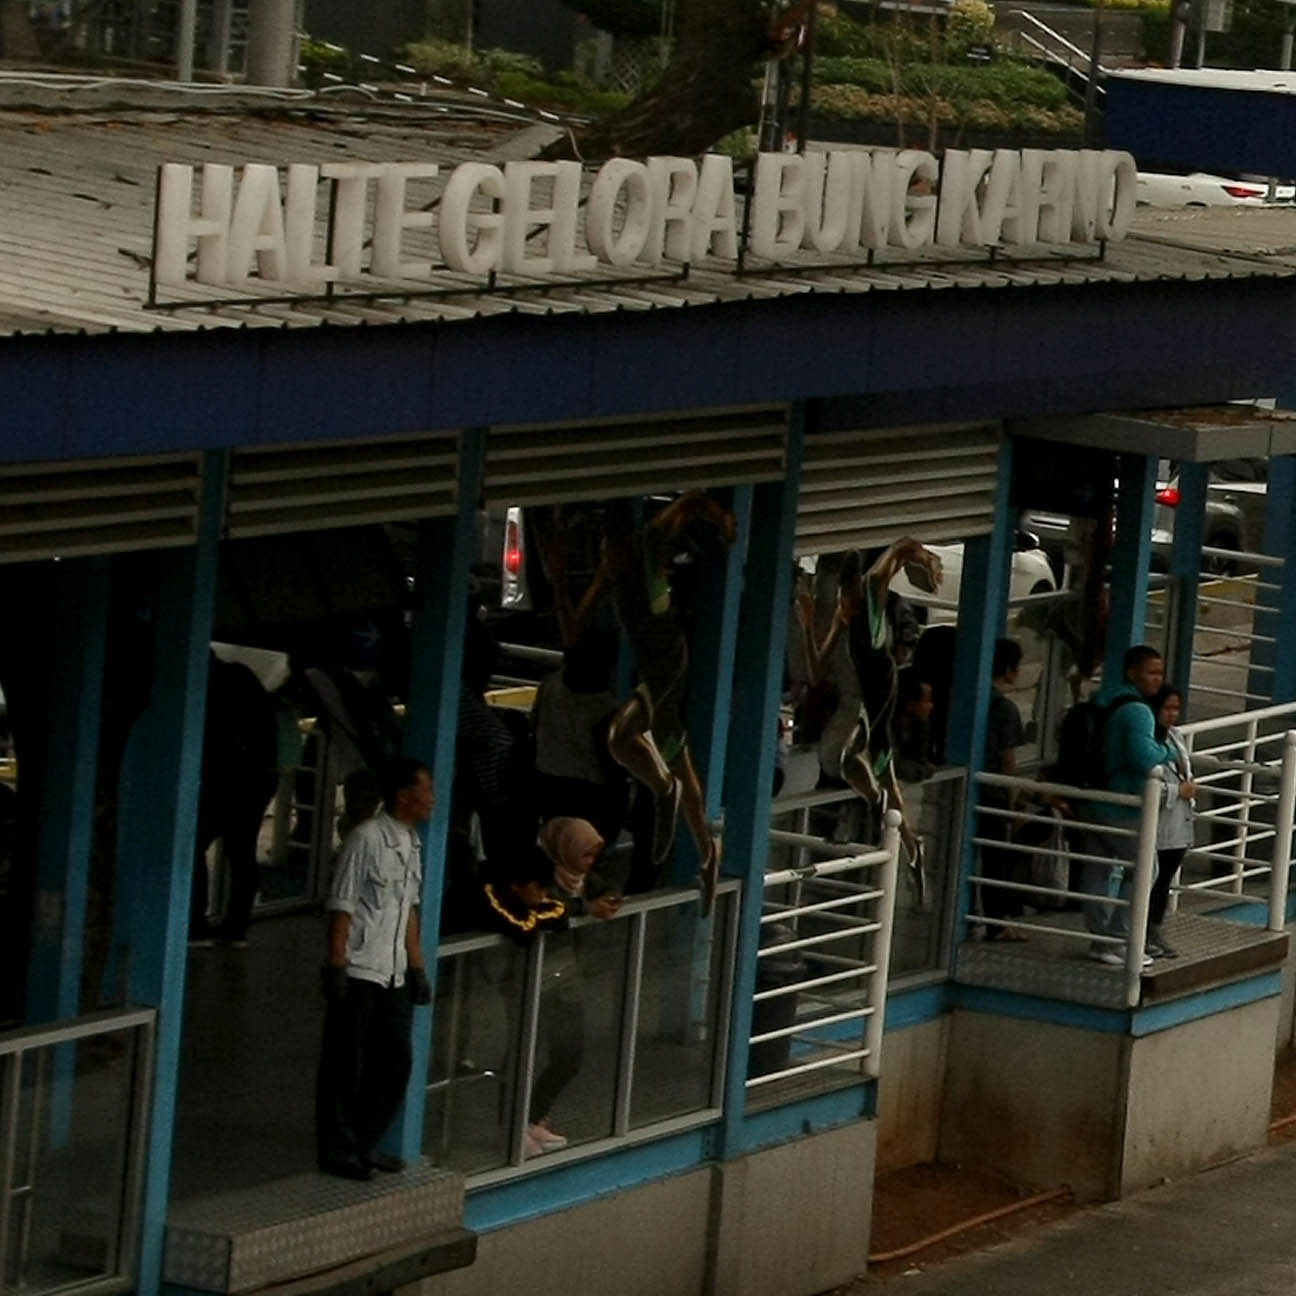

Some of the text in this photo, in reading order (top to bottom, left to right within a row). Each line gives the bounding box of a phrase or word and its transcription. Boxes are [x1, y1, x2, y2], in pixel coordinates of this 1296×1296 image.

[154, 147, 1138, 284] HALTE GELORA BUNG KARNO
